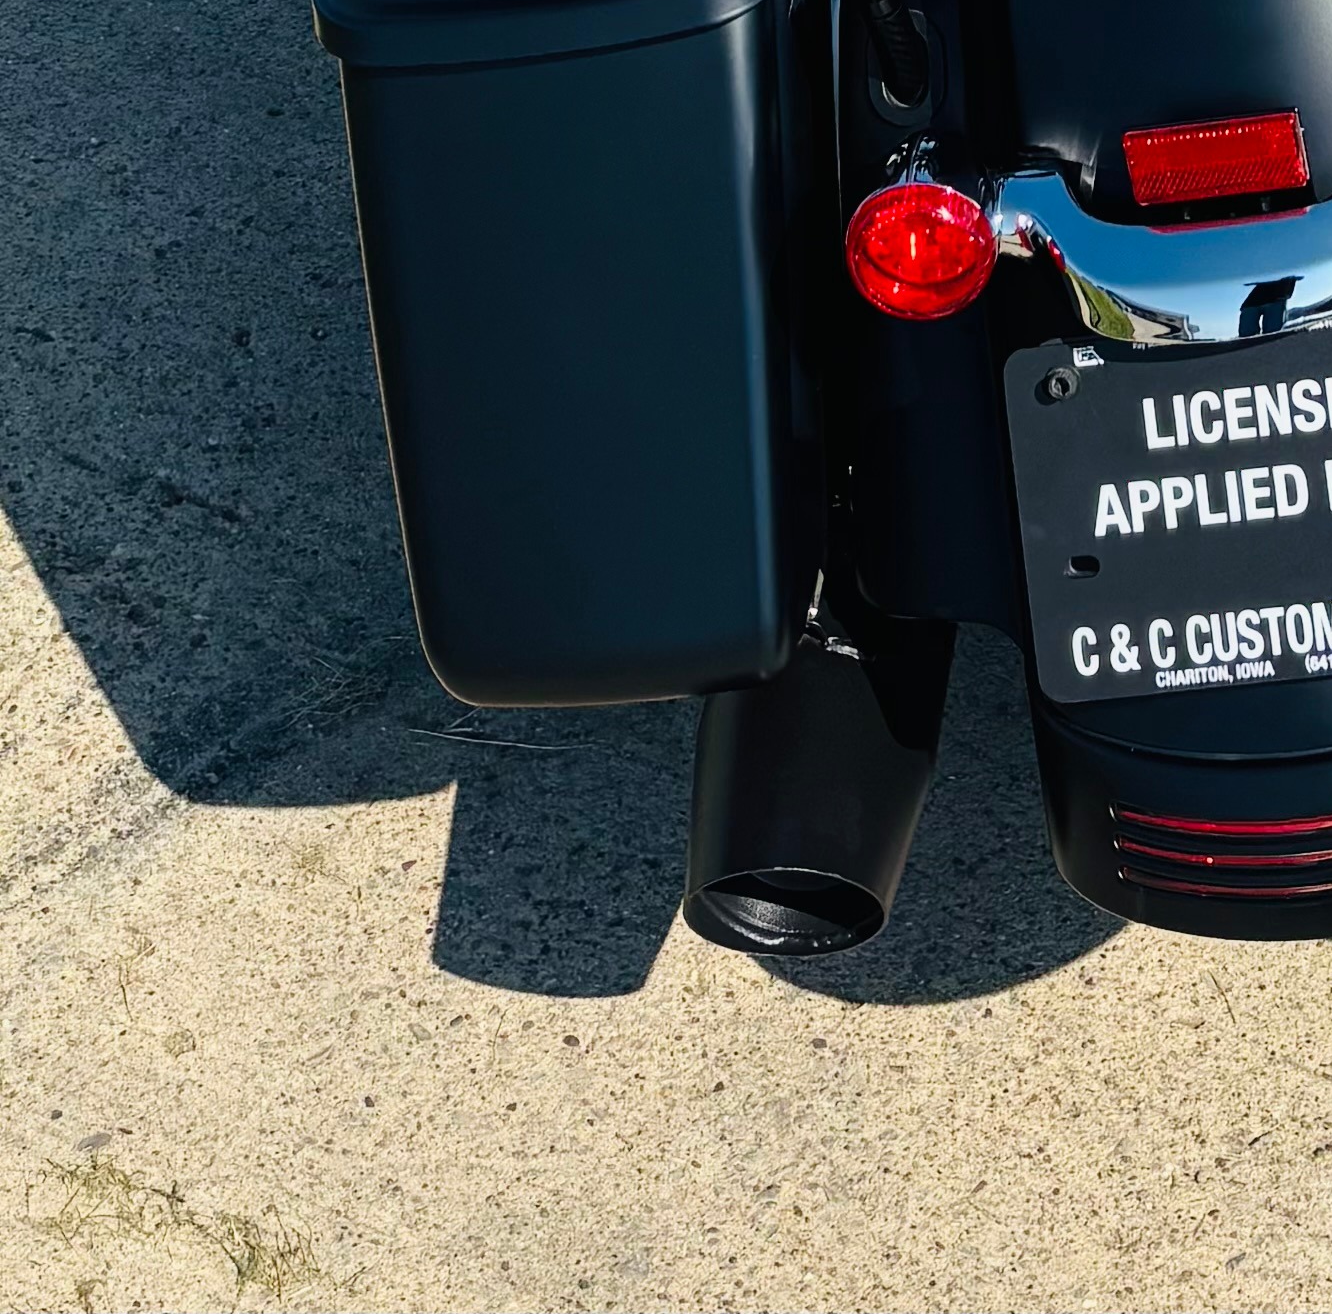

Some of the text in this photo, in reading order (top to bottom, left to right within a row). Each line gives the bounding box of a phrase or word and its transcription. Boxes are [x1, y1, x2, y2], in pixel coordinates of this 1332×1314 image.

[1094, 463, 1309, 537] APPLIED
[1071, 626, 1100, 677] C
[1109, 623, 1142, 673] &
[1148, 618, 1176, 669] C
[1155, 664, 1234, 688] CHARITON,
[1235, 659, 1276, 680] IOWA
